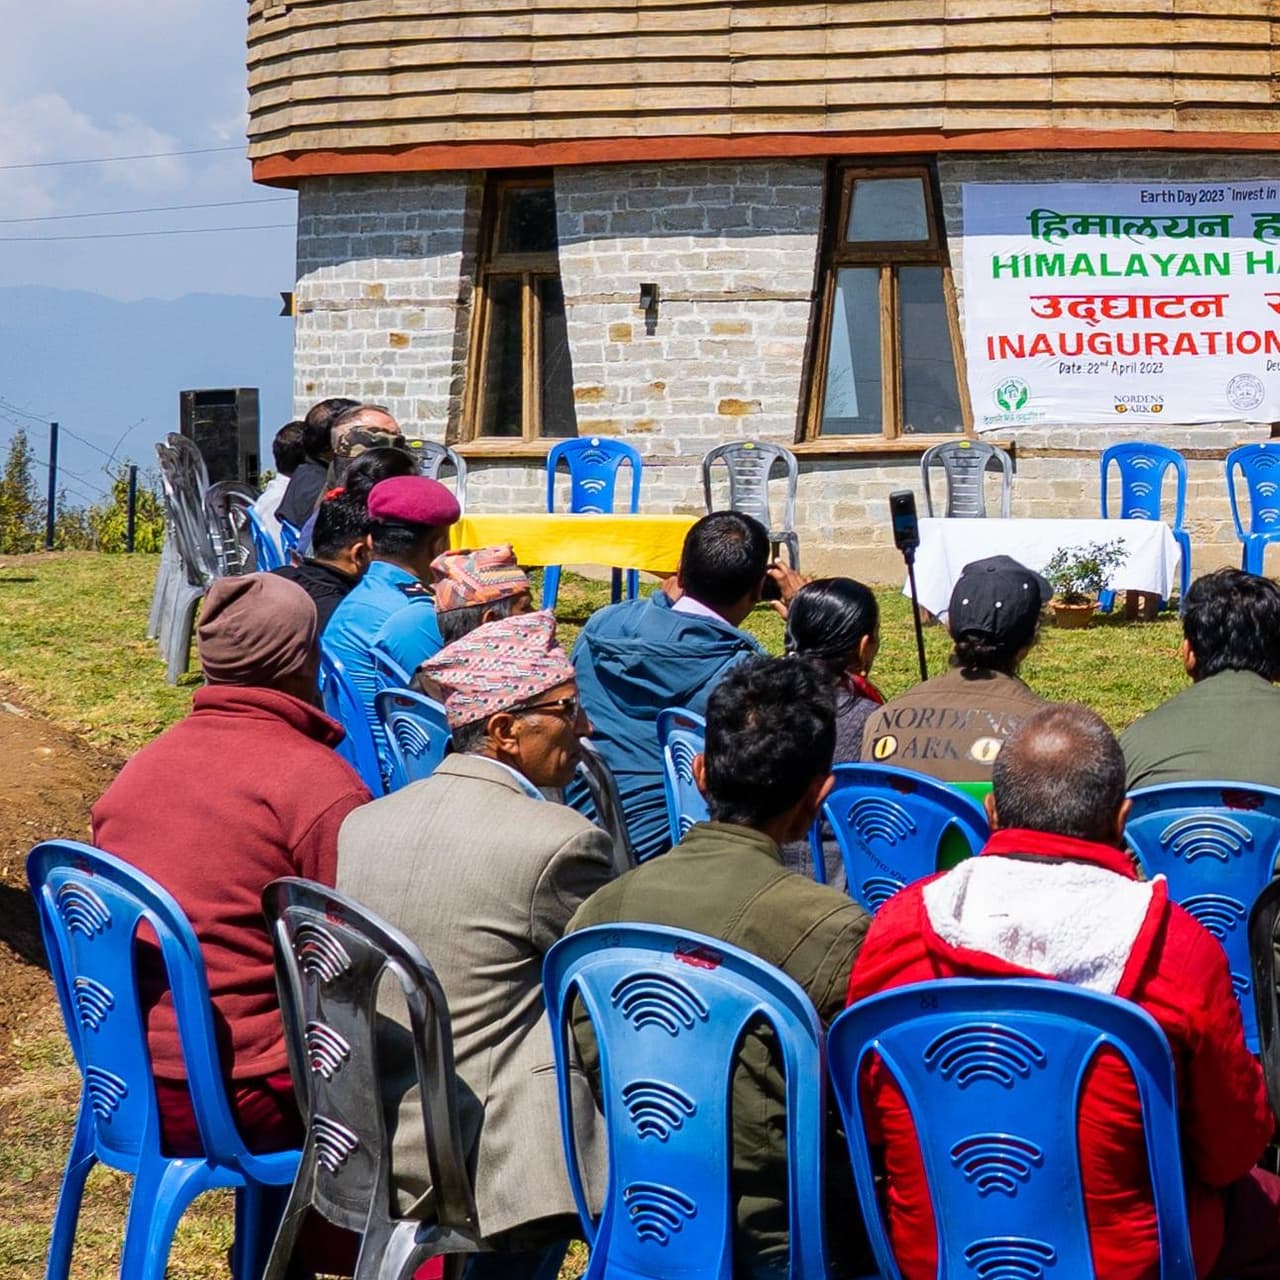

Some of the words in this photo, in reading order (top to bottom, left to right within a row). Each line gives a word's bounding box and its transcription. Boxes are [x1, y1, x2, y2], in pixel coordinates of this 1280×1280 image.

[1140, 189, 1174, 203] Earth
[1177, 189, 1198, 206] Day
[1199, 189, 1225, 203] 2023
[1026, 208, 1234, 246] हिमालयन
[992, 252, 1231, 279] HIMALAYAN
[1111, 361, 1137, 376] April
[1140, 362, 1164, 374] 2023
[1113, 394, 1164, 403] NORDENS
[1130, 404, 1150, 413] ARK
[902, 736, 960, 760] ARK
